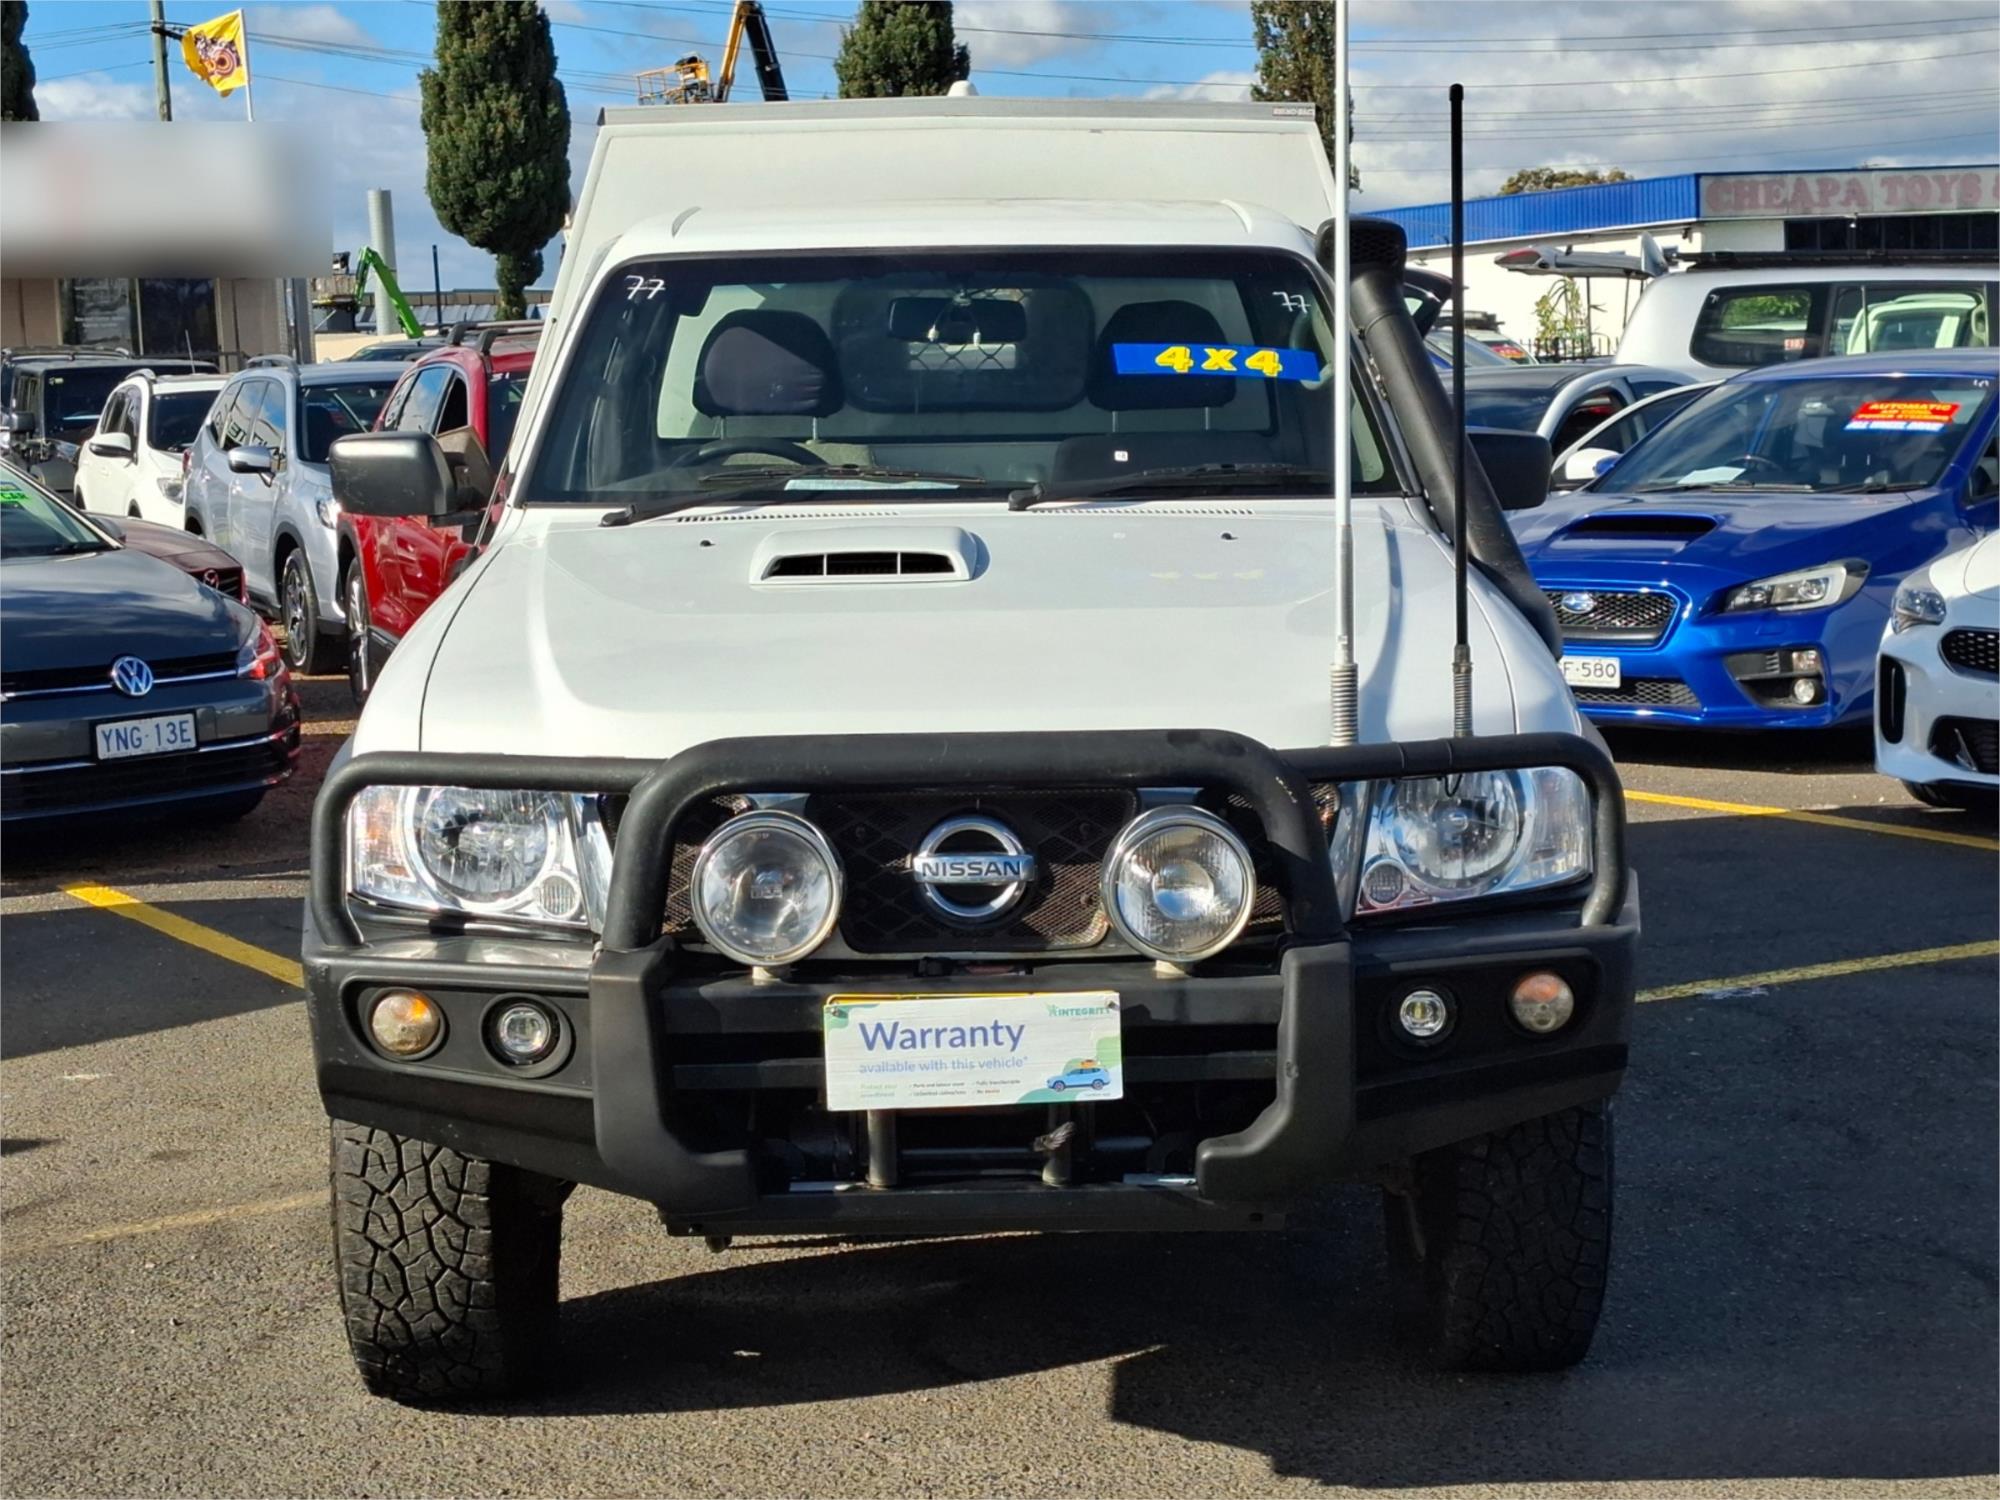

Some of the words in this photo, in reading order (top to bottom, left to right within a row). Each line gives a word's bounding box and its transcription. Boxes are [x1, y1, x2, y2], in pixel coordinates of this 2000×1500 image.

[1706, 177, 1868, 211] CHEAPA
[1880, 173, 1982, 205] TOYS
[921, 861, 1022, 877] NISSAN
[858, 1018, 1026, 1053] Warranty
[859, 1057, 915, 1074] available
[917, 1059, 947, 1072] with
[951, 1058, 975, 1071] this
